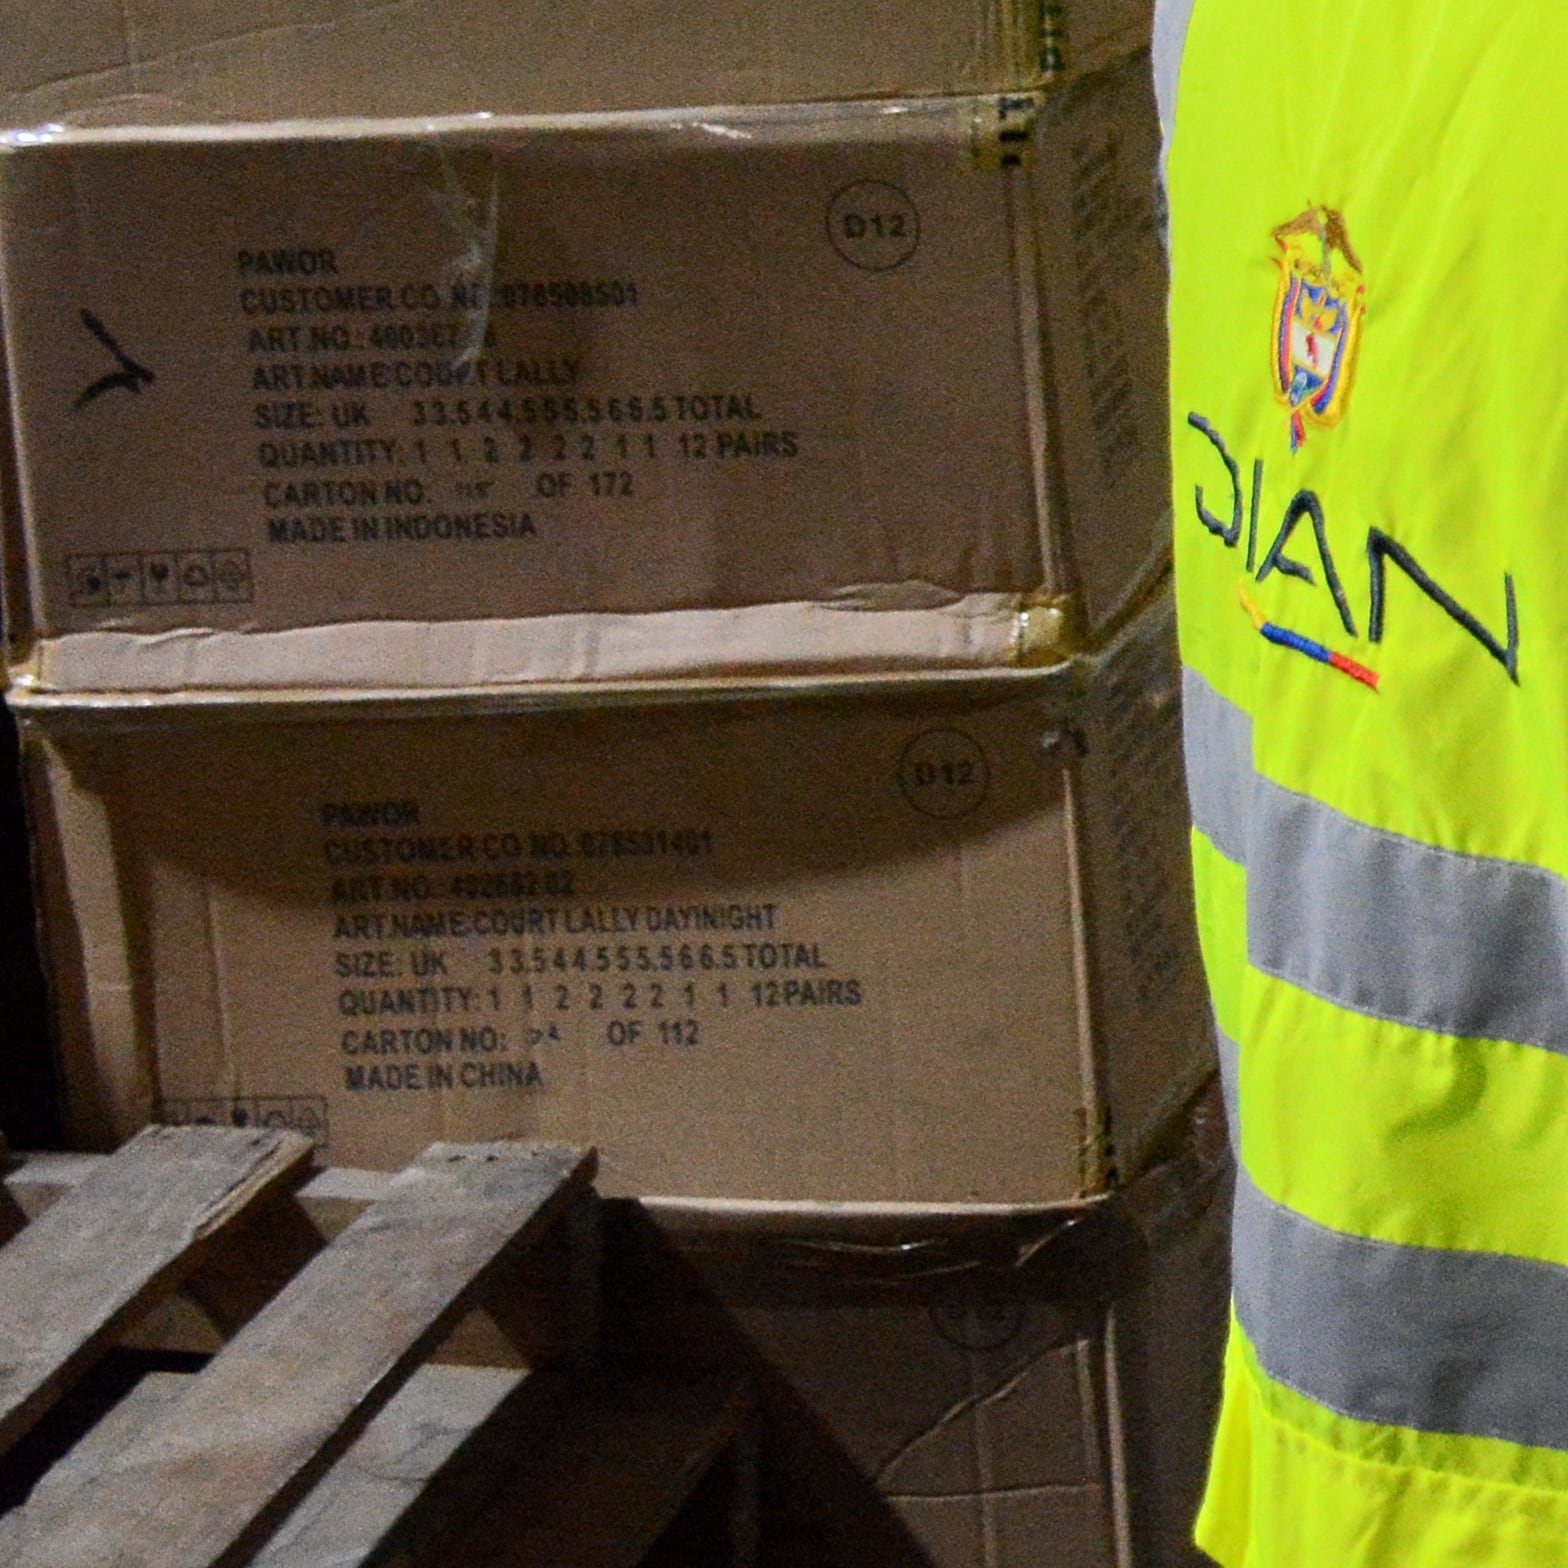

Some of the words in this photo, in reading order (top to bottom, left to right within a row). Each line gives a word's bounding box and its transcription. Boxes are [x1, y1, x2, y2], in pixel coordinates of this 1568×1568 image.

[844, 214, 906, 239] D12
[237, 248, 339, 276] PAWOR
[240, 286, 394, 315] CUSTOMER
[401, 284, 440, 312] CO
[498, 358, 580, 385] LALLY
[331, 398, 372, 428] UK
[672, 393, 762, 421] TOTAL
[677, 432, 707, 459] 12
[715, 430, 799, 458] PAIRS
[263, 480, 377, 508] CARTON
[537, 471, 573, 498] OF
[590, 470, 635, 497] 172
[268, 516, 346, 545] MADE
[352, 515, 379, 542] IN
[384, 511, 537, 541] INDONESIA
[915, 760, 975, 786] D12
[322, 835, 476, 865] CUSTOMER
[482, 833, 522, 860] CO
[565, 905, 639, 934] LALLY
[410, 949, 449, 977] UK
[741, 942, 827, 969] TOTAL
[782, 978, 863, 1007] PAIRS
[341, 1027, 454, 1056] CARTON
[606, 1019, 643, 1047] OF
[657, 1018, 700, 1046] 112
[345, 1063, 422, 1091] MADE
[428, 1062, 453, 1090] IN
[460, 1060, 544, 1089] CHINA
